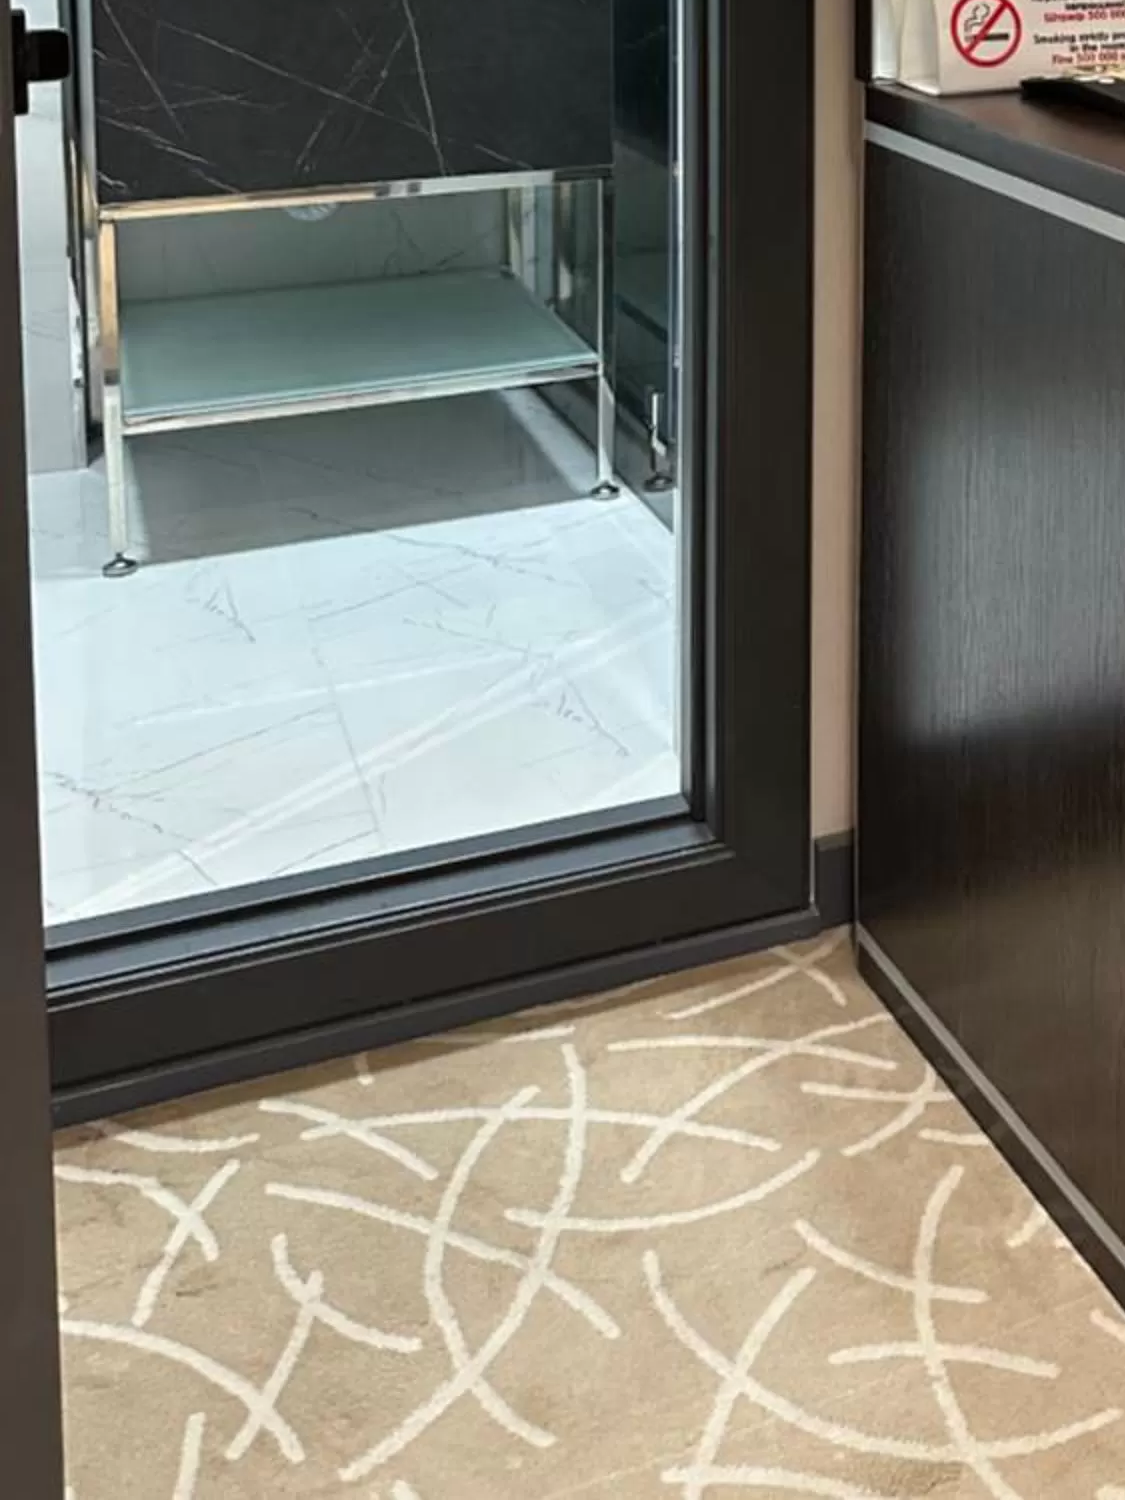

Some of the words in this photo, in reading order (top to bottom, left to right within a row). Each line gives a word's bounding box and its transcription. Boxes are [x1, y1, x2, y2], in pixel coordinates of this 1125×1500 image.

[1033, 33, 1076, 44] Smoking
[1081, 43, 1098, 51] the
[1052, 54, 1073, 64] Fine
